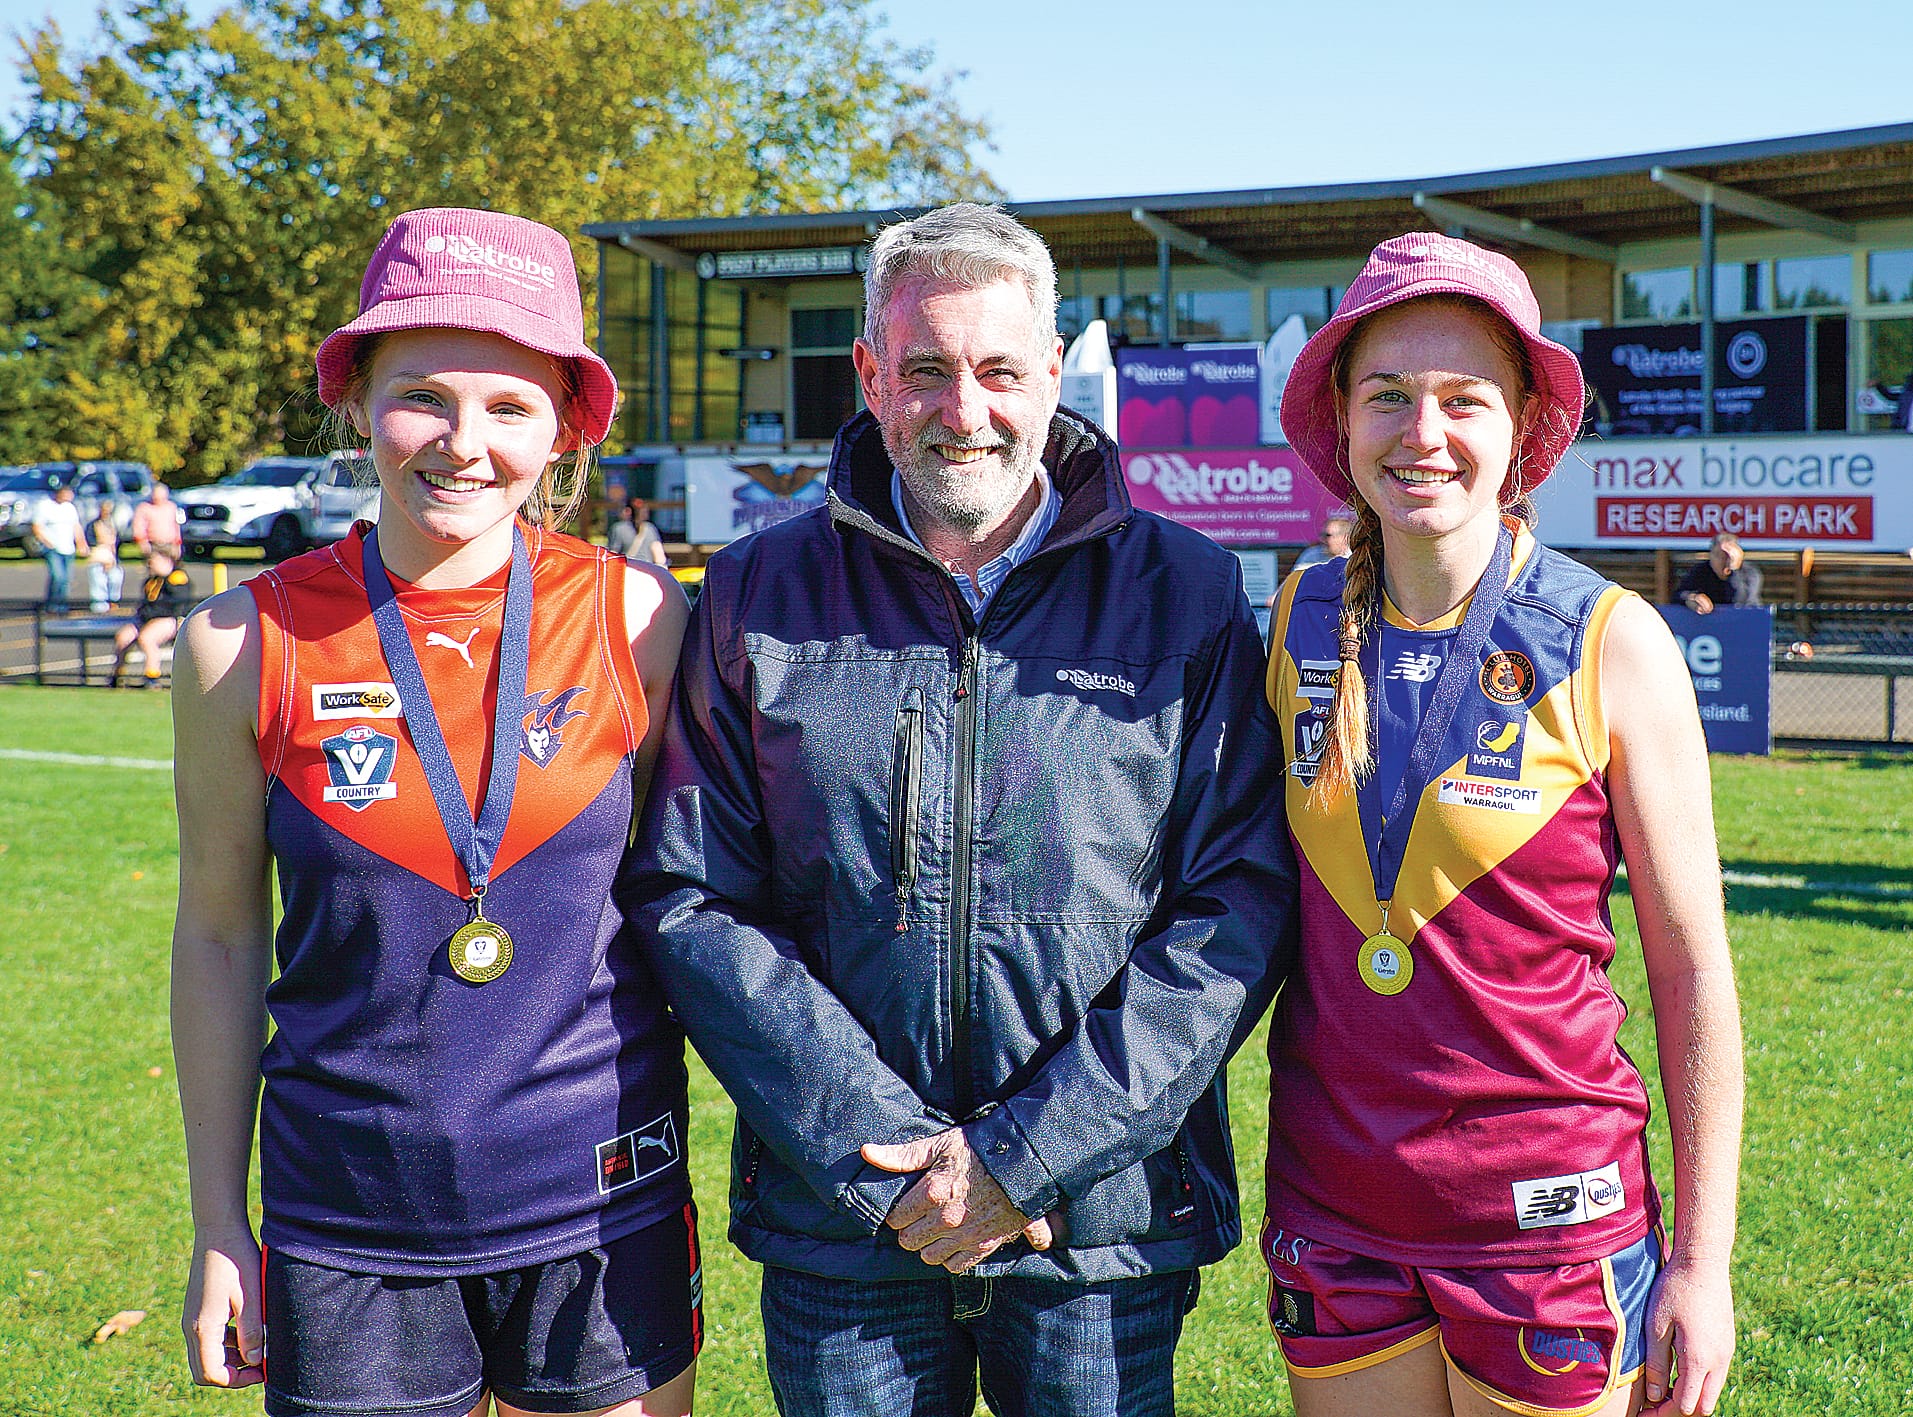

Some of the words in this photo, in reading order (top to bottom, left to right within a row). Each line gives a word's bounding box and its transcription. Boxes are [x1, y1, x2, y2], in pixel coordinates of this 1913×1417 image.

[446, 238, 553, 284] Latrobe
[1158, 458, 1293, 493] Latrobe
[1594, 457, 1684, 488] max
[1701, 446, 1874, 488] biocare
[1606, 503, 1767, 535] RESEARCH
[1774, 503, 1858, 536] PARK
[1072, 671, 1136, 693] Latrobe
[1303, 671, 1339, 684] WorkS
[345, 729, 374, 738] AFL
[1296, 763, 1318, 776] COUNT
[1473, 754, 1516, 769] MPFNL
[336, 786, 381, 798] COUNTRY
[1454, 781, 1538, 801] INTERSPORT
[1463, 796, 1516, 811] WARRAGUL
[1594, 1181, 1622, 1201] DUSTIES
[1532, 1330, 1602, 1364] DUSTIES
